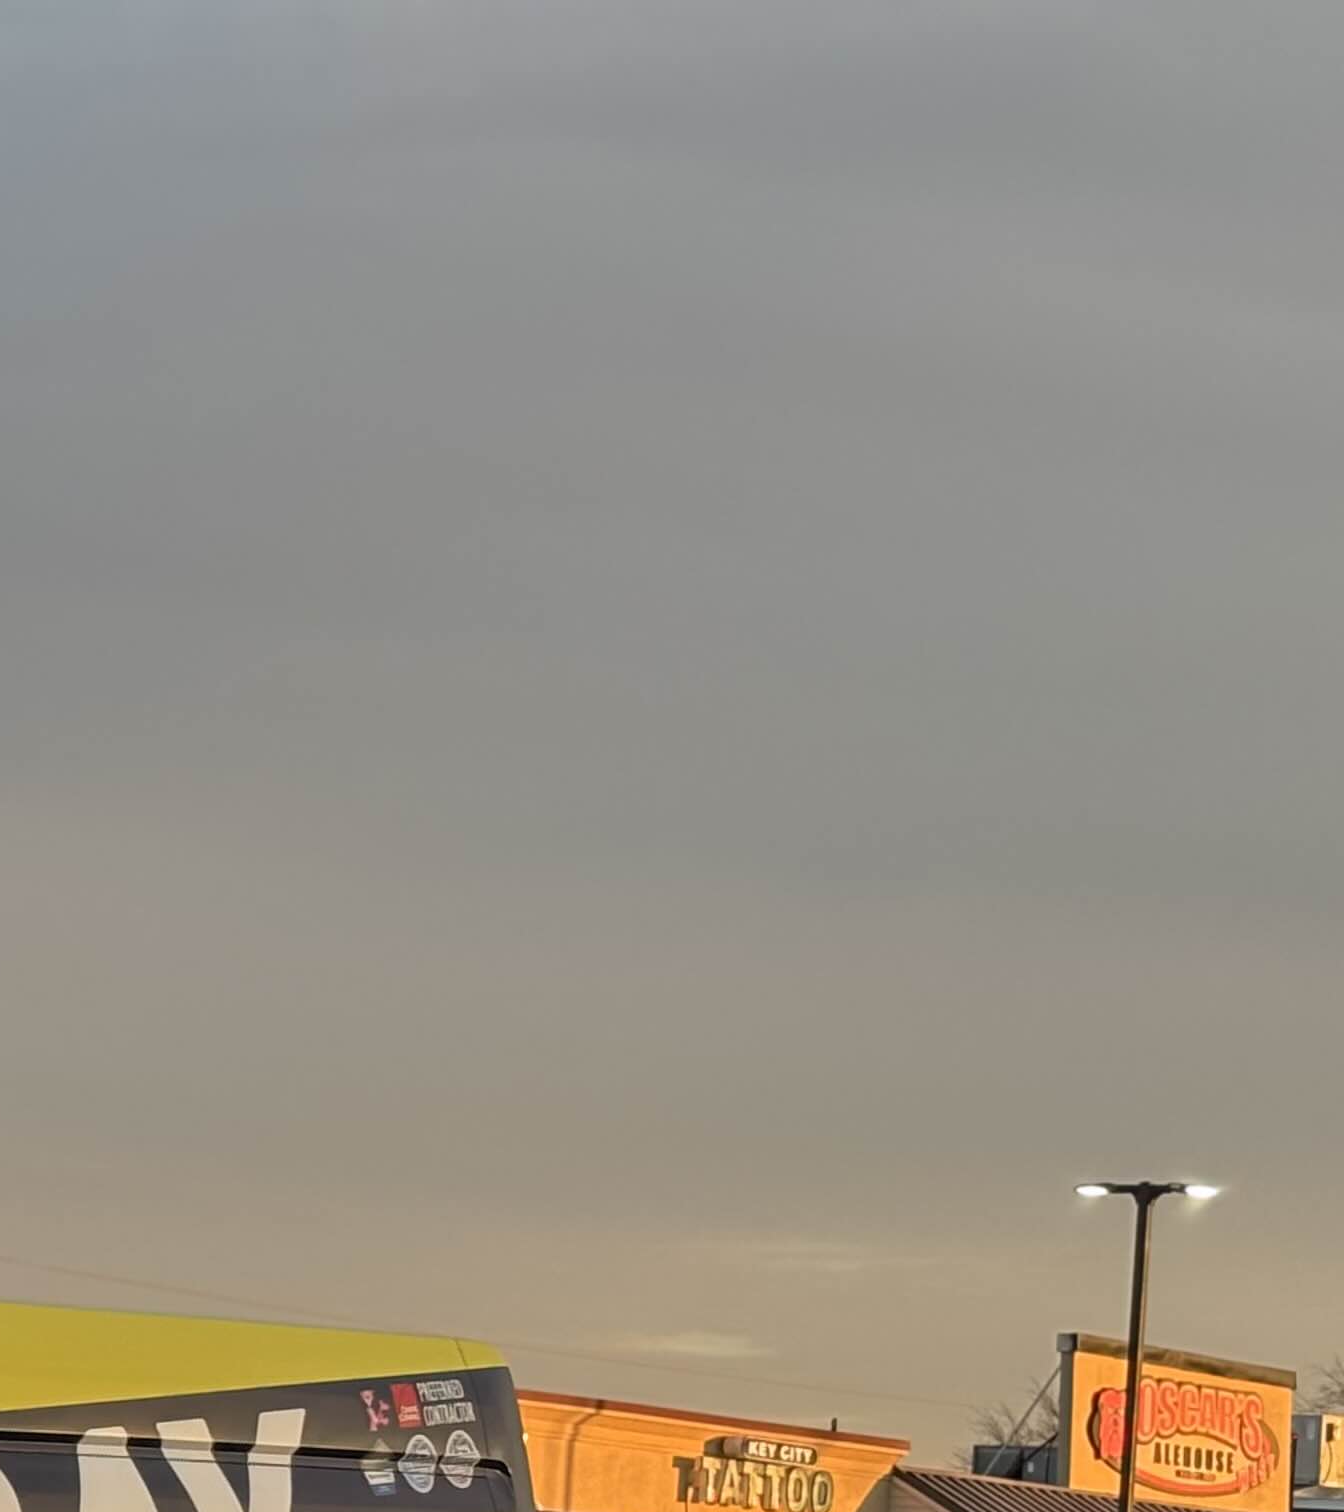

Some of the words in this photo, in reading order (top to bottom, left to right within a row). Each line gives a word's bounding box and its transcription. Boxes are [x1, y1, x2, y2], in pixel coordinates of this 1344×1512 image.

[1137, 1376, 1263, 1460] OSCAR'S
[748, 1440, 778, 1458] KEY
[780, 1446, 814, 1464] CITY
[1153, 1442, 1234, 1474] ALEHOUSE
